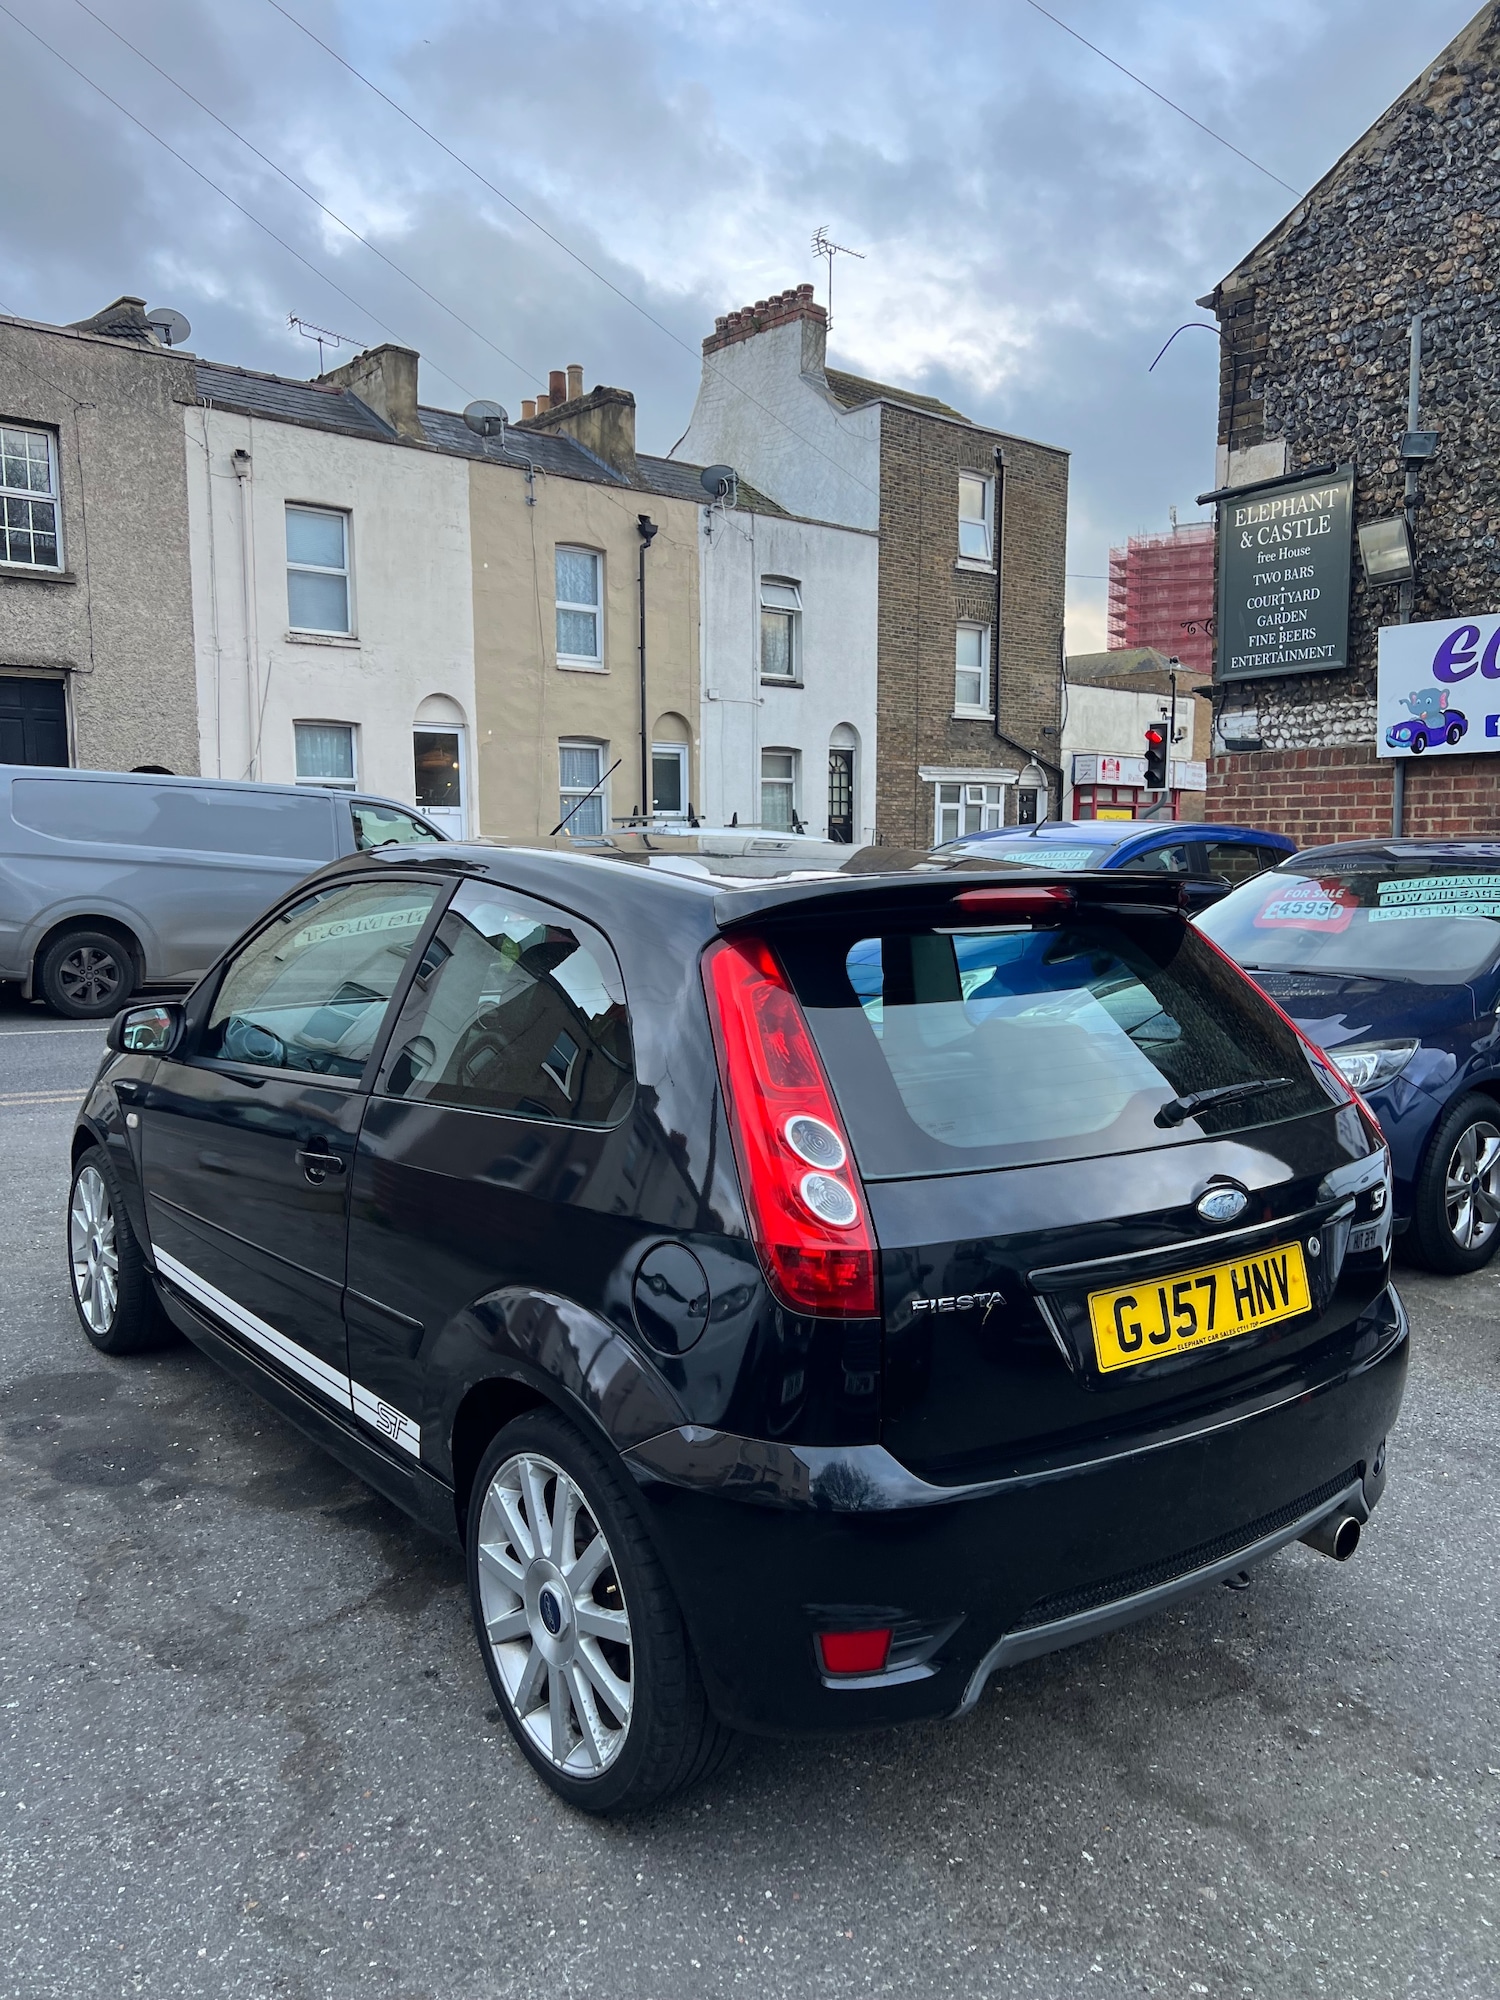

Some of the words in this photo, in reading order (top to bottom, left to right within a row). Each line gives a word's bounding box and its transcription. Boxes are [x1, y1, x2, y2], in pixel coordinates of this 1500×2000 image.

[1234, 488, 1339, 527] ELEPHANT
[1240, 531, 1253, 549] &
[1257, 515, 1331, 546] CASTLE
[1257, 549, 1276, 564] free
[1278, 546, 1311, 560] House
[1253, 571, 1281, 586] TWO
[1284, 565, 1314, 582] BARS
[1246, 587, 1320, 610] COURTYARD
[1257, 609, 1308, 627] GARDEN
[1248, 631, 1276, 648] FINE
[1279, 627, 1316, 644] BEERS
[1231, 644, 1335, 669] ENTERTAINMENT
[1284, 889, 1310, 898] FOR
[1312, 888, 1346, 898] SALE
[1383, 876, 1500, 891] AUTOMATIC
[1384, 893, 1421, 904] LOW
[1426, 889, 1500, 901] MILEAGE
[1373, 906, 1431, 919] LONG
[911, 1291, 1007, 1325] FIESTA
[1113, 1275, 1217, 1353] GJ57
[1230, 1254, 1290, 1322] HNV
[1177, 1337, 1206, 1351] ELEPHANT
[1207, 1333, 1219, 1342] CAR
[1220, 1328, 1236, 1337] SALES
[376, 1401, 408, 1440] ST
